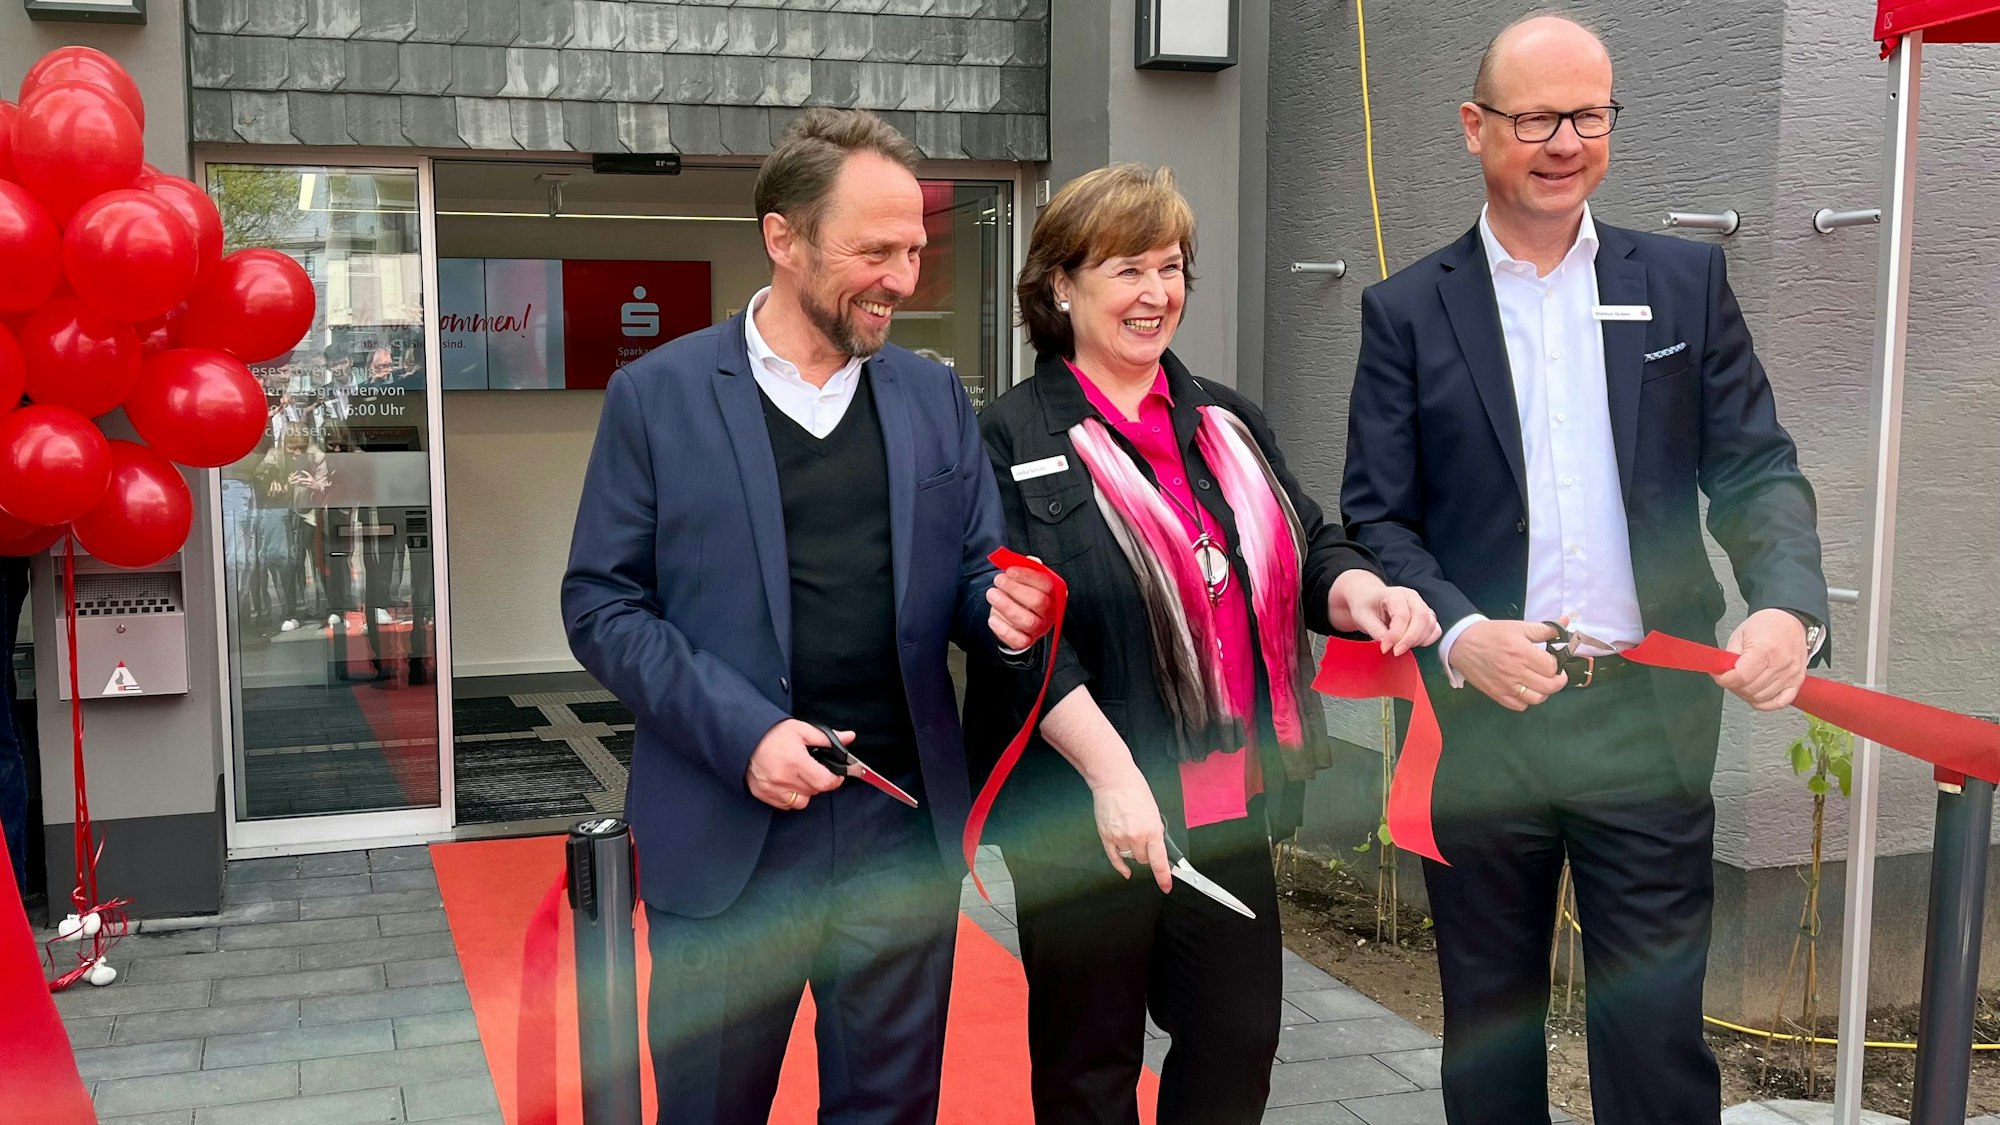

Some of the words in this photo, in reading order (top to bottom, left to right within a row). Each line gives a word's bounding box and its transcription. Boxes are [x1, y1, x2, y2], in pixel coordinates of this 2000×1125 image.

[440, 303, 532, 338] ommen!
[442, 340, 466, 349] sind.
[381, 387, 404, 396] von
[970, 386, 985, 394] Uhr
[380, 404, 405, 416] Uhr
